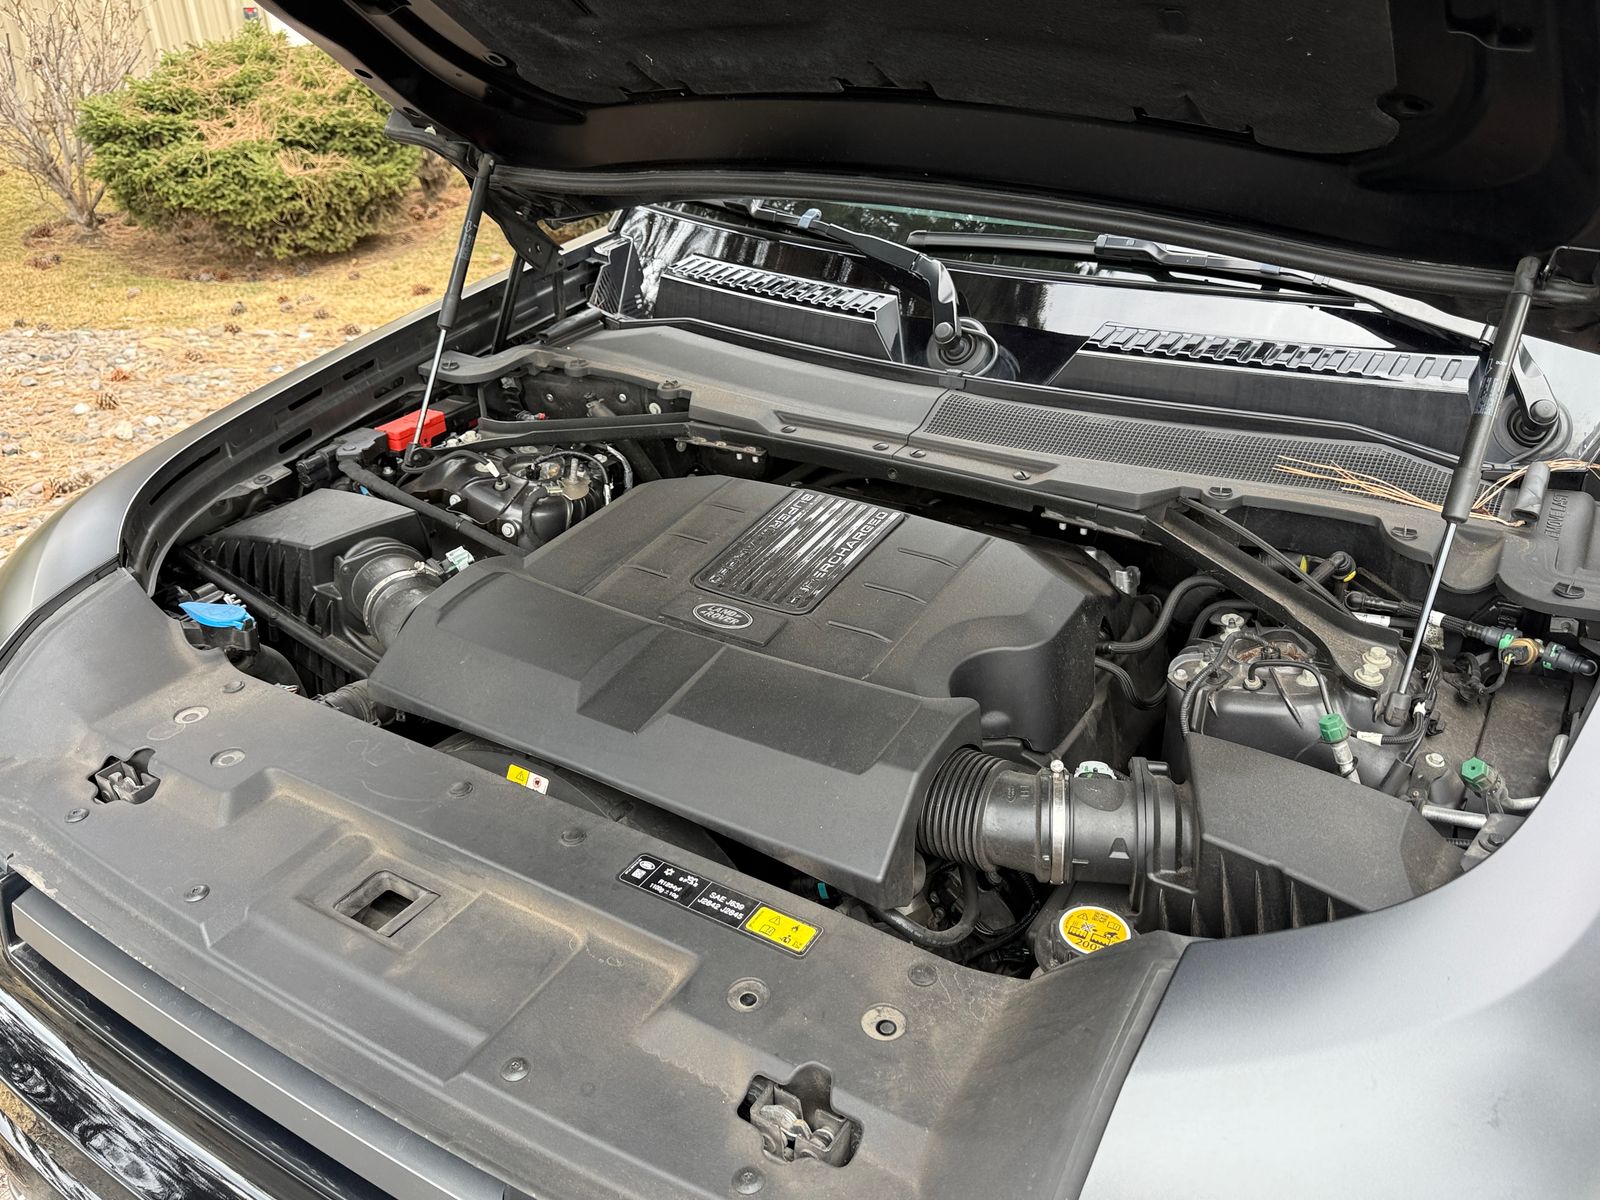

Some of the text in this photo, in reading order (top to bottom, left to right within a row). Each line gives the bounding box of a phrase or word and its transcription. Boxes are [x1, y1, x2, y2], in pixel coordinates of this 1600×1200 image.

[790, 511, 889, 605] ERCHARGED
[702, 610, 740, 625] ROVER
[707, 605, 738, 617] LAND
[709, 891, 745, 911] SAE J639
[1074, 938, 1101, 951] 200
